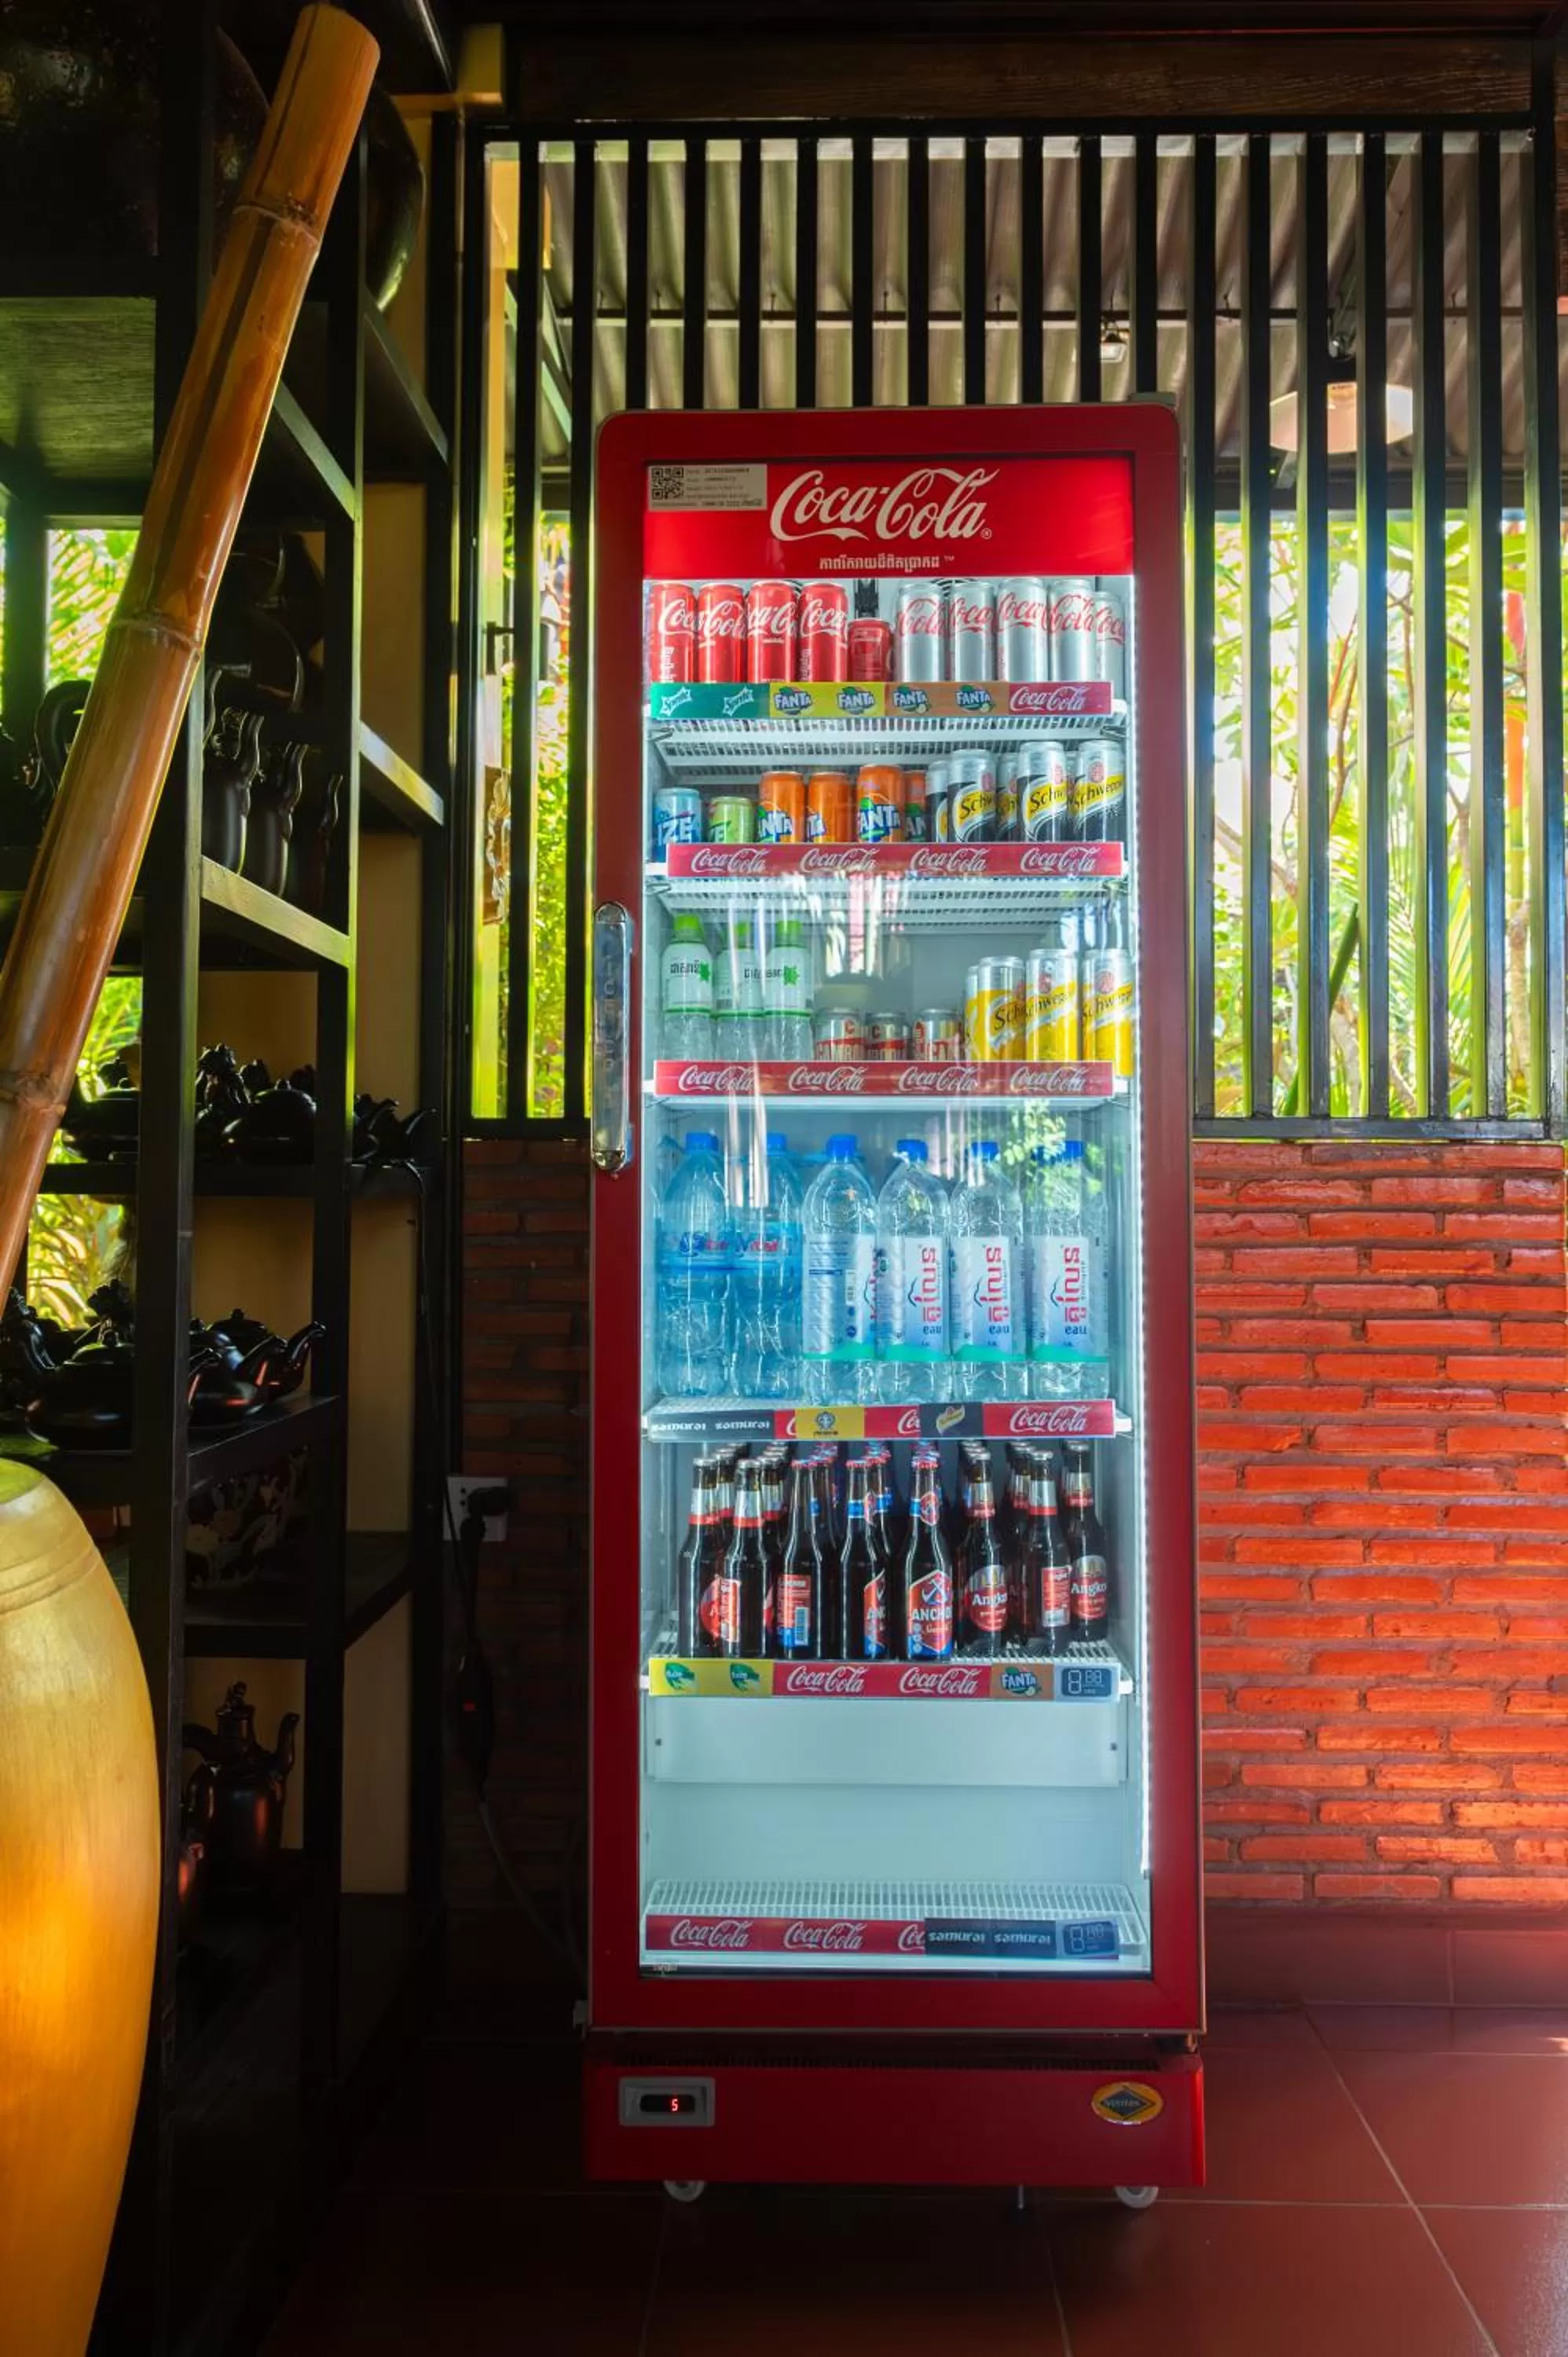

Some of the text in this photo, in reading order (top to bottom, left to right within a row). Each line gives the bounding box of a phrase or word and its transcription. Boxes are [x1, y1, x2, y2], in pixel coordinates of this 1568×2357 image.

[770, 468, 1000, 541] Coca-Cola
[774, 693, 811, 708] FANTA
[838, 693, 874, 708] FANTA
[892, 691, 928, 706] FANTA
[955, 691, 991, 706] FANTA
[1009, 685, 1090, 711] Coca-Cola
[859, 805, 901, 833] ANTA
[691, 848, 771, 873] Coca-Cola
[800, 848, 880, 873] Coca-Cola
[910, 848, 989, 872] Coca-Cola
[1020, 847, 1100, 873] Coca-Cola
[679, 1065, 756, 1091] Coca-Cola
[789, 1065, 867, 1091] Coca-Cola
[899, 1066, 979, 1091] Coca-Cola
[1009, 1066, 1089, 1091] Coca-Cola
[1009, 1405, 1091, 1432] Coca-Cola
[787, 1665, 867, 1693] Coca-Cola
[899, 1666, 981, 1695] Coca-Cola
[1002, 1673, 1036, 1688] FANTA
[671, 1919, 753, 1948] Coca-Cola
[783, 1921, 866, 1950] Coca-Cola
[672, 2099, 679, 2111] 5
